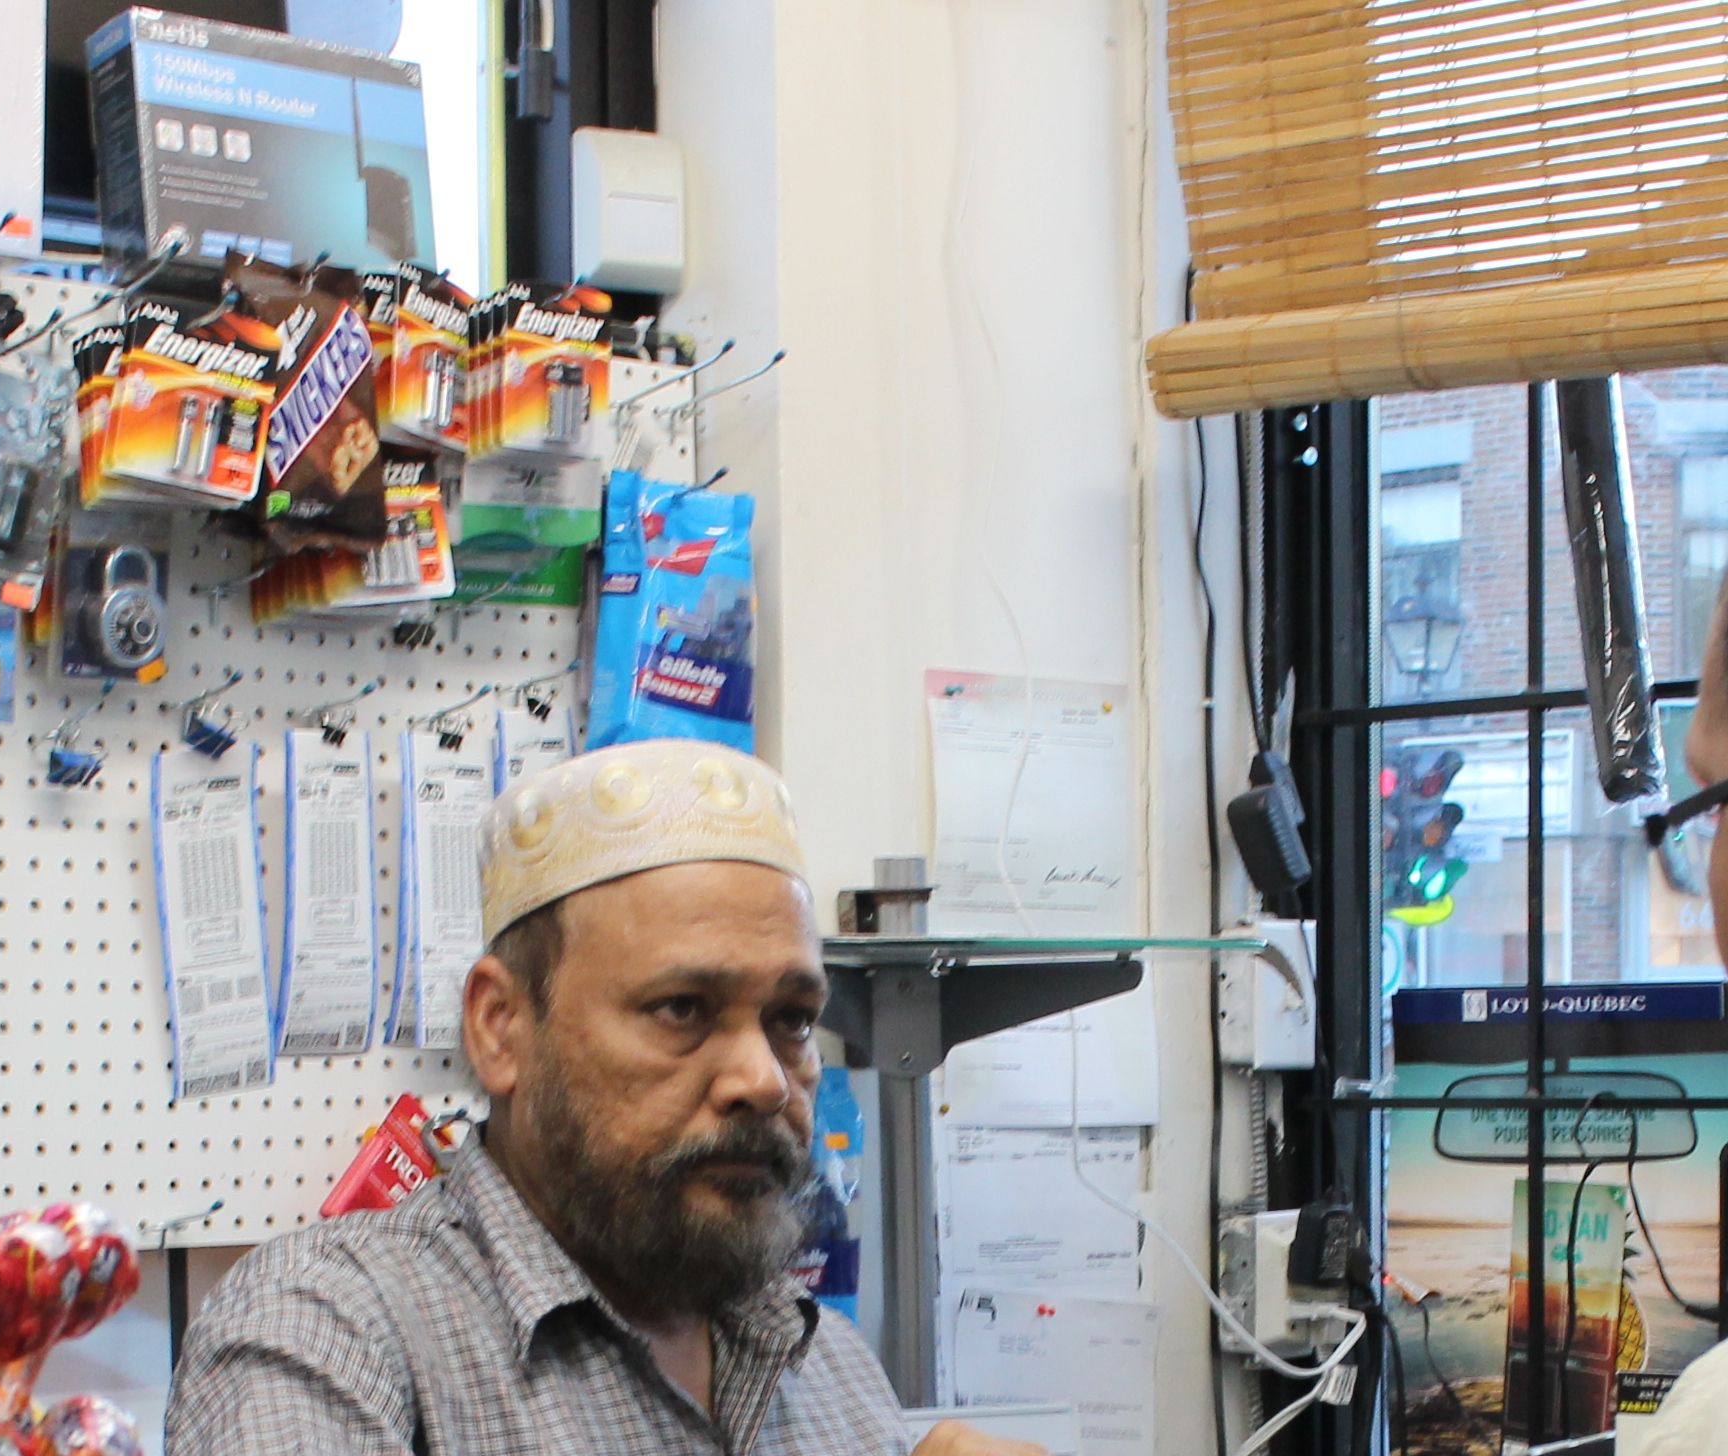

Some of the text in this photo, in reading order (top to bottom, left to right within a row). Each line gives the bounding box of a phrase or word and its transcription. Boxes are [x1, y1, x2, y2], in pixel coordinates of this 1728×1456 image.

[154, 75, 234, 104] Wireless
[256, 90, 318, 118] Router
[514, 302, 604, 342] Energizer
[145, 324, 270, 380] Energizer
[268, 306, 372, 476] SNICKERS
[659, 655, 726, 687] Gillette
